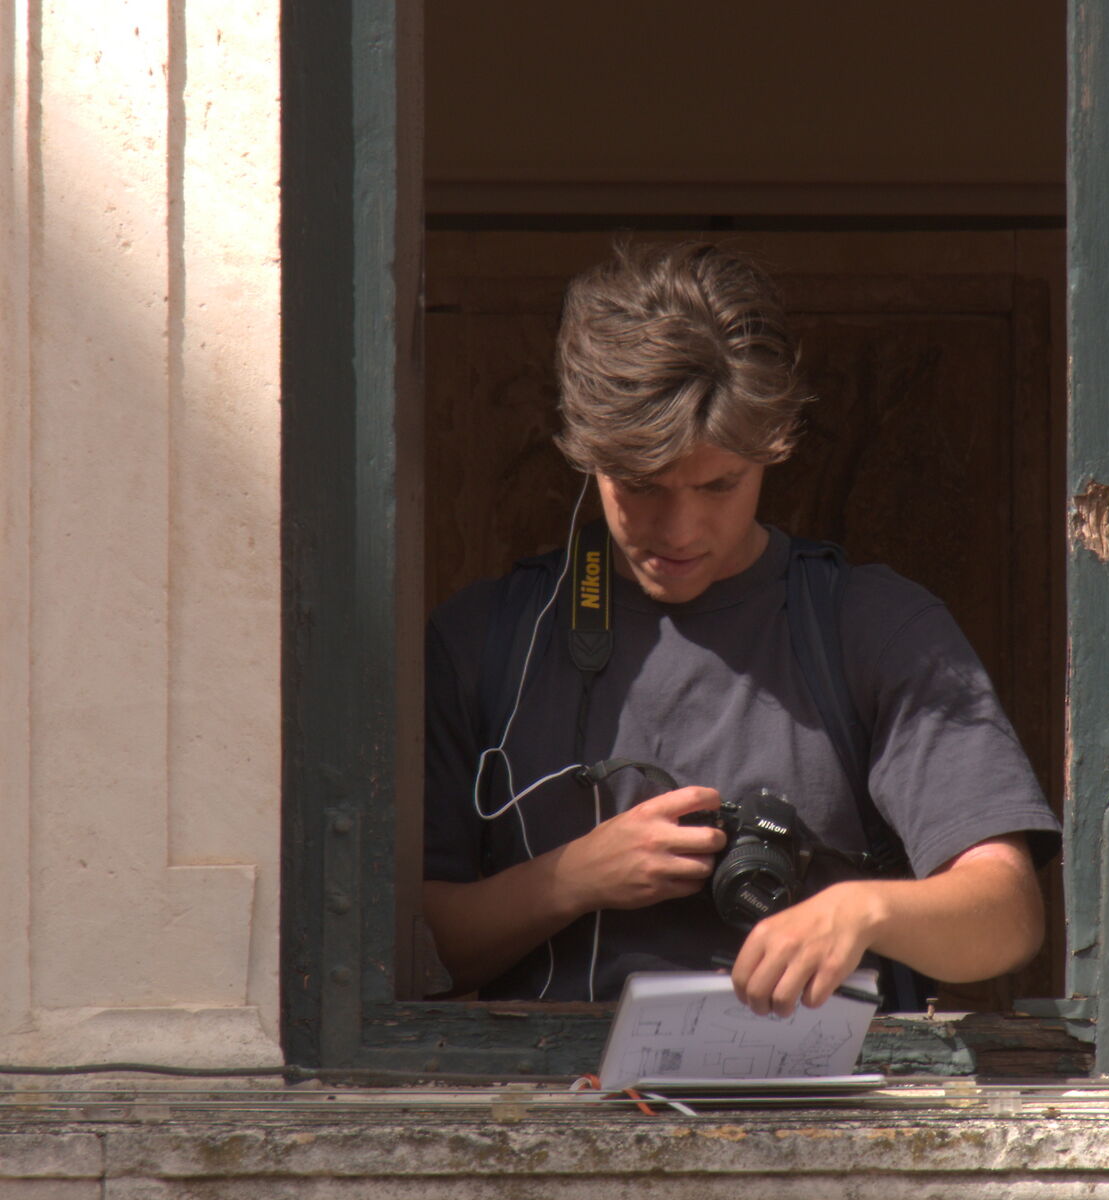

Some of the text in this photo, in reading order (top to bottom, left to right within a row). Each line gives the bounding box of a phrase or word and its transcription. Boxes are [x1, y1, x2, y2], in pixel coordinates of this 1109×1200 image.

[581, 551, 600, 609] Nikon
[757, 819, 788, 835] Nikon
[740, 890, 769, 913] Nikon
